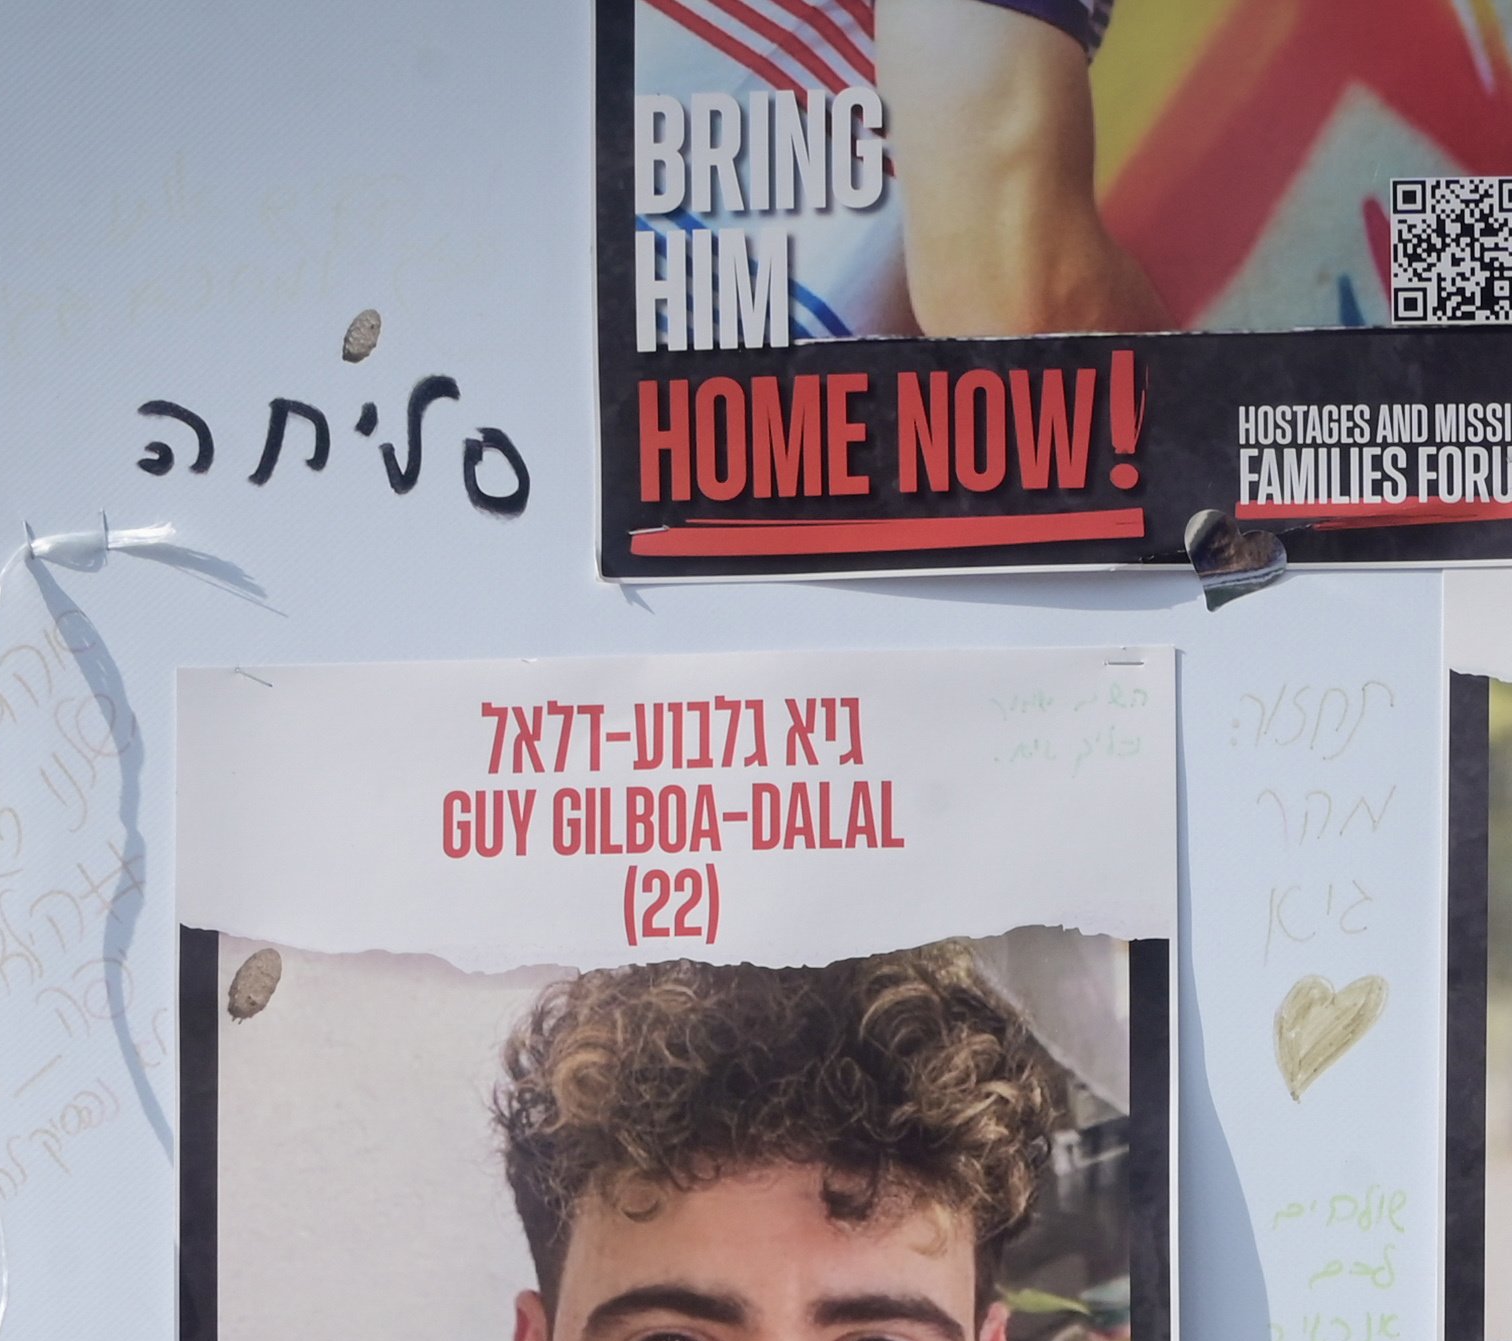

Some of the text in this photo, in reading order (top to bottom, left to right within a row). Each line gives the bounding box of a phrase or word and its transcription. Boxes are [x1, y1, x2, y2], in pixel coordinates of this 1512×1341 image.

[136, 372, 532, 518] סליחה
[1239, 404, 1370, 444] HOSTAGES
[1376, 404, 1428, 443] AND
[1240, 447, 1406, 505] FAMILIES
[483, 695, 863, 774] גיא גלבוע-דלאל
[444, 781, 904, 858] GUY GILBOA-DALAL
[625, 864, 720, 946] (22)
